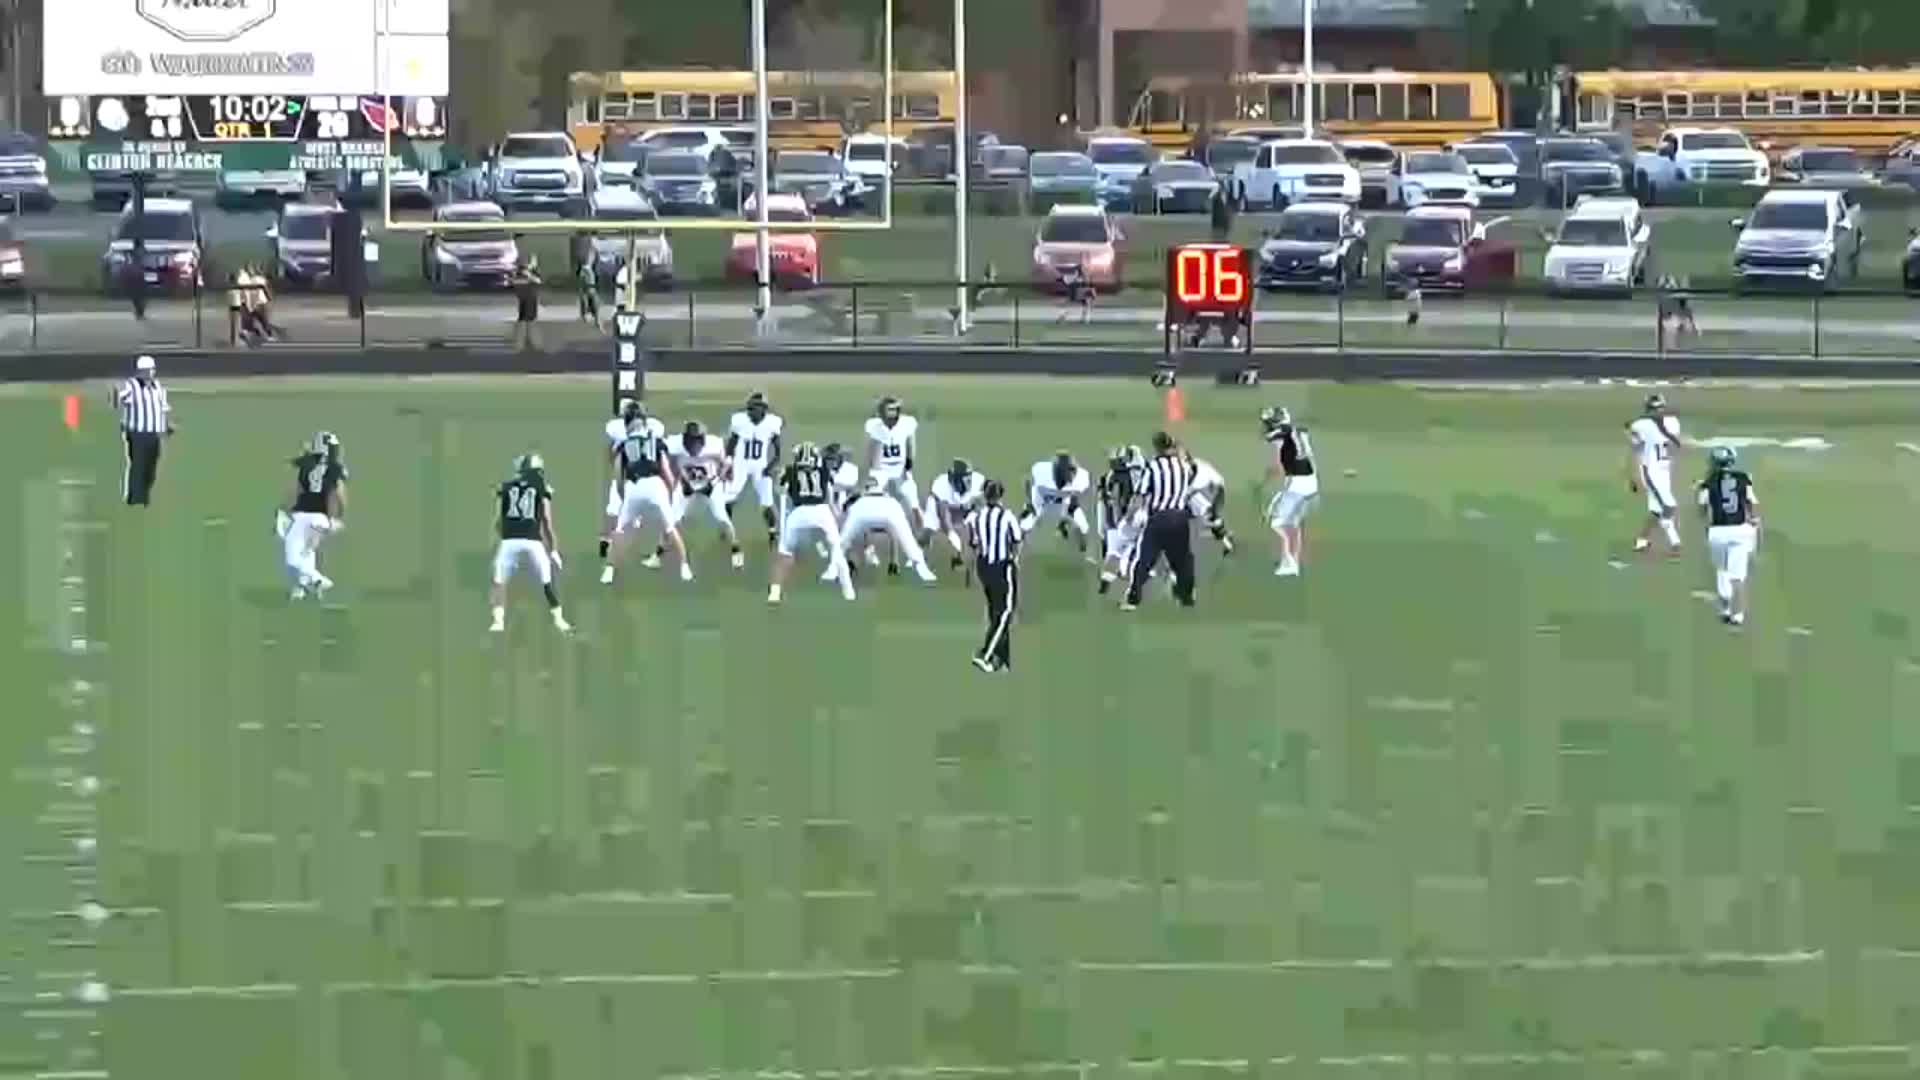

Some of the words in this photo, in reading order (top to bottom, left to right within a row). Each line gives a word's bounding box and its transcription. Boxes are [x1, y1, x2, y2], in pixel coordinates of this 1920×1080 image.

[209, 96, 286, 121] 10:02
[214, 122, 251, 138] QTR
[1177, 248, 1244, 303] 06
[744, 439, 763, 460] 10
[796, 470, 823, 498] 11
[1719, 477, 1739, 514] 5
